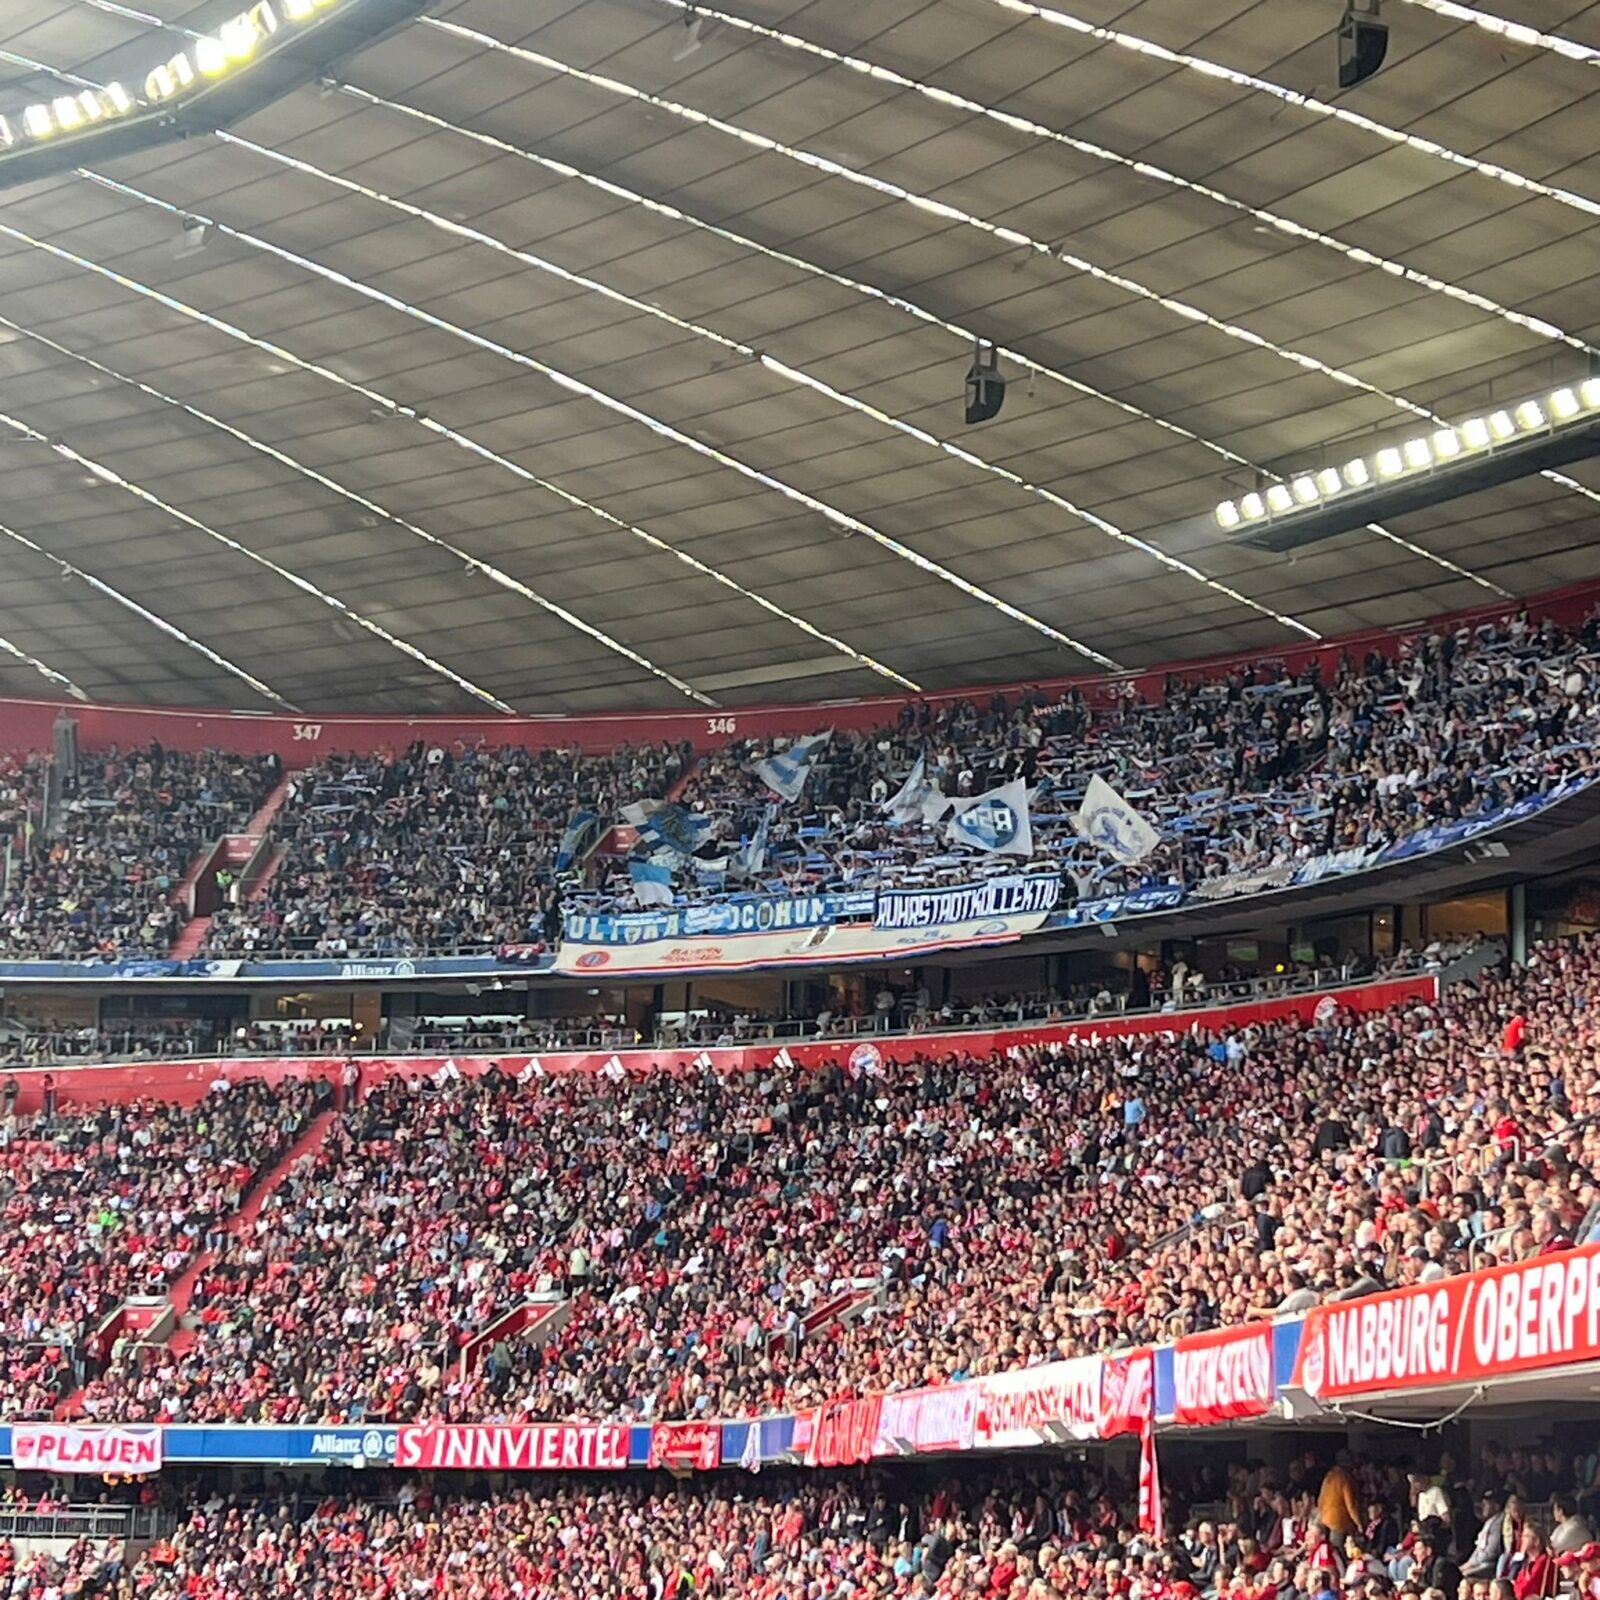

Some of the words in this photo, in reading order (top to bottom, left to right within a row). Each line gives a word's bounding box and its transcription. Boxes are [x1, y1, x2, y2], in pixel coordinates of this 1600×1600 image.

[292, 724, 322, 740] 347
[707, 718, 736, 734] 346
[342, 964, 392, 976] Allianz
[1329, 1289, 1449, 1387] NABBURG
[37, 1435, 156, 1463] PLAUEN
[311, 1434, 361, 1453] Allianz
